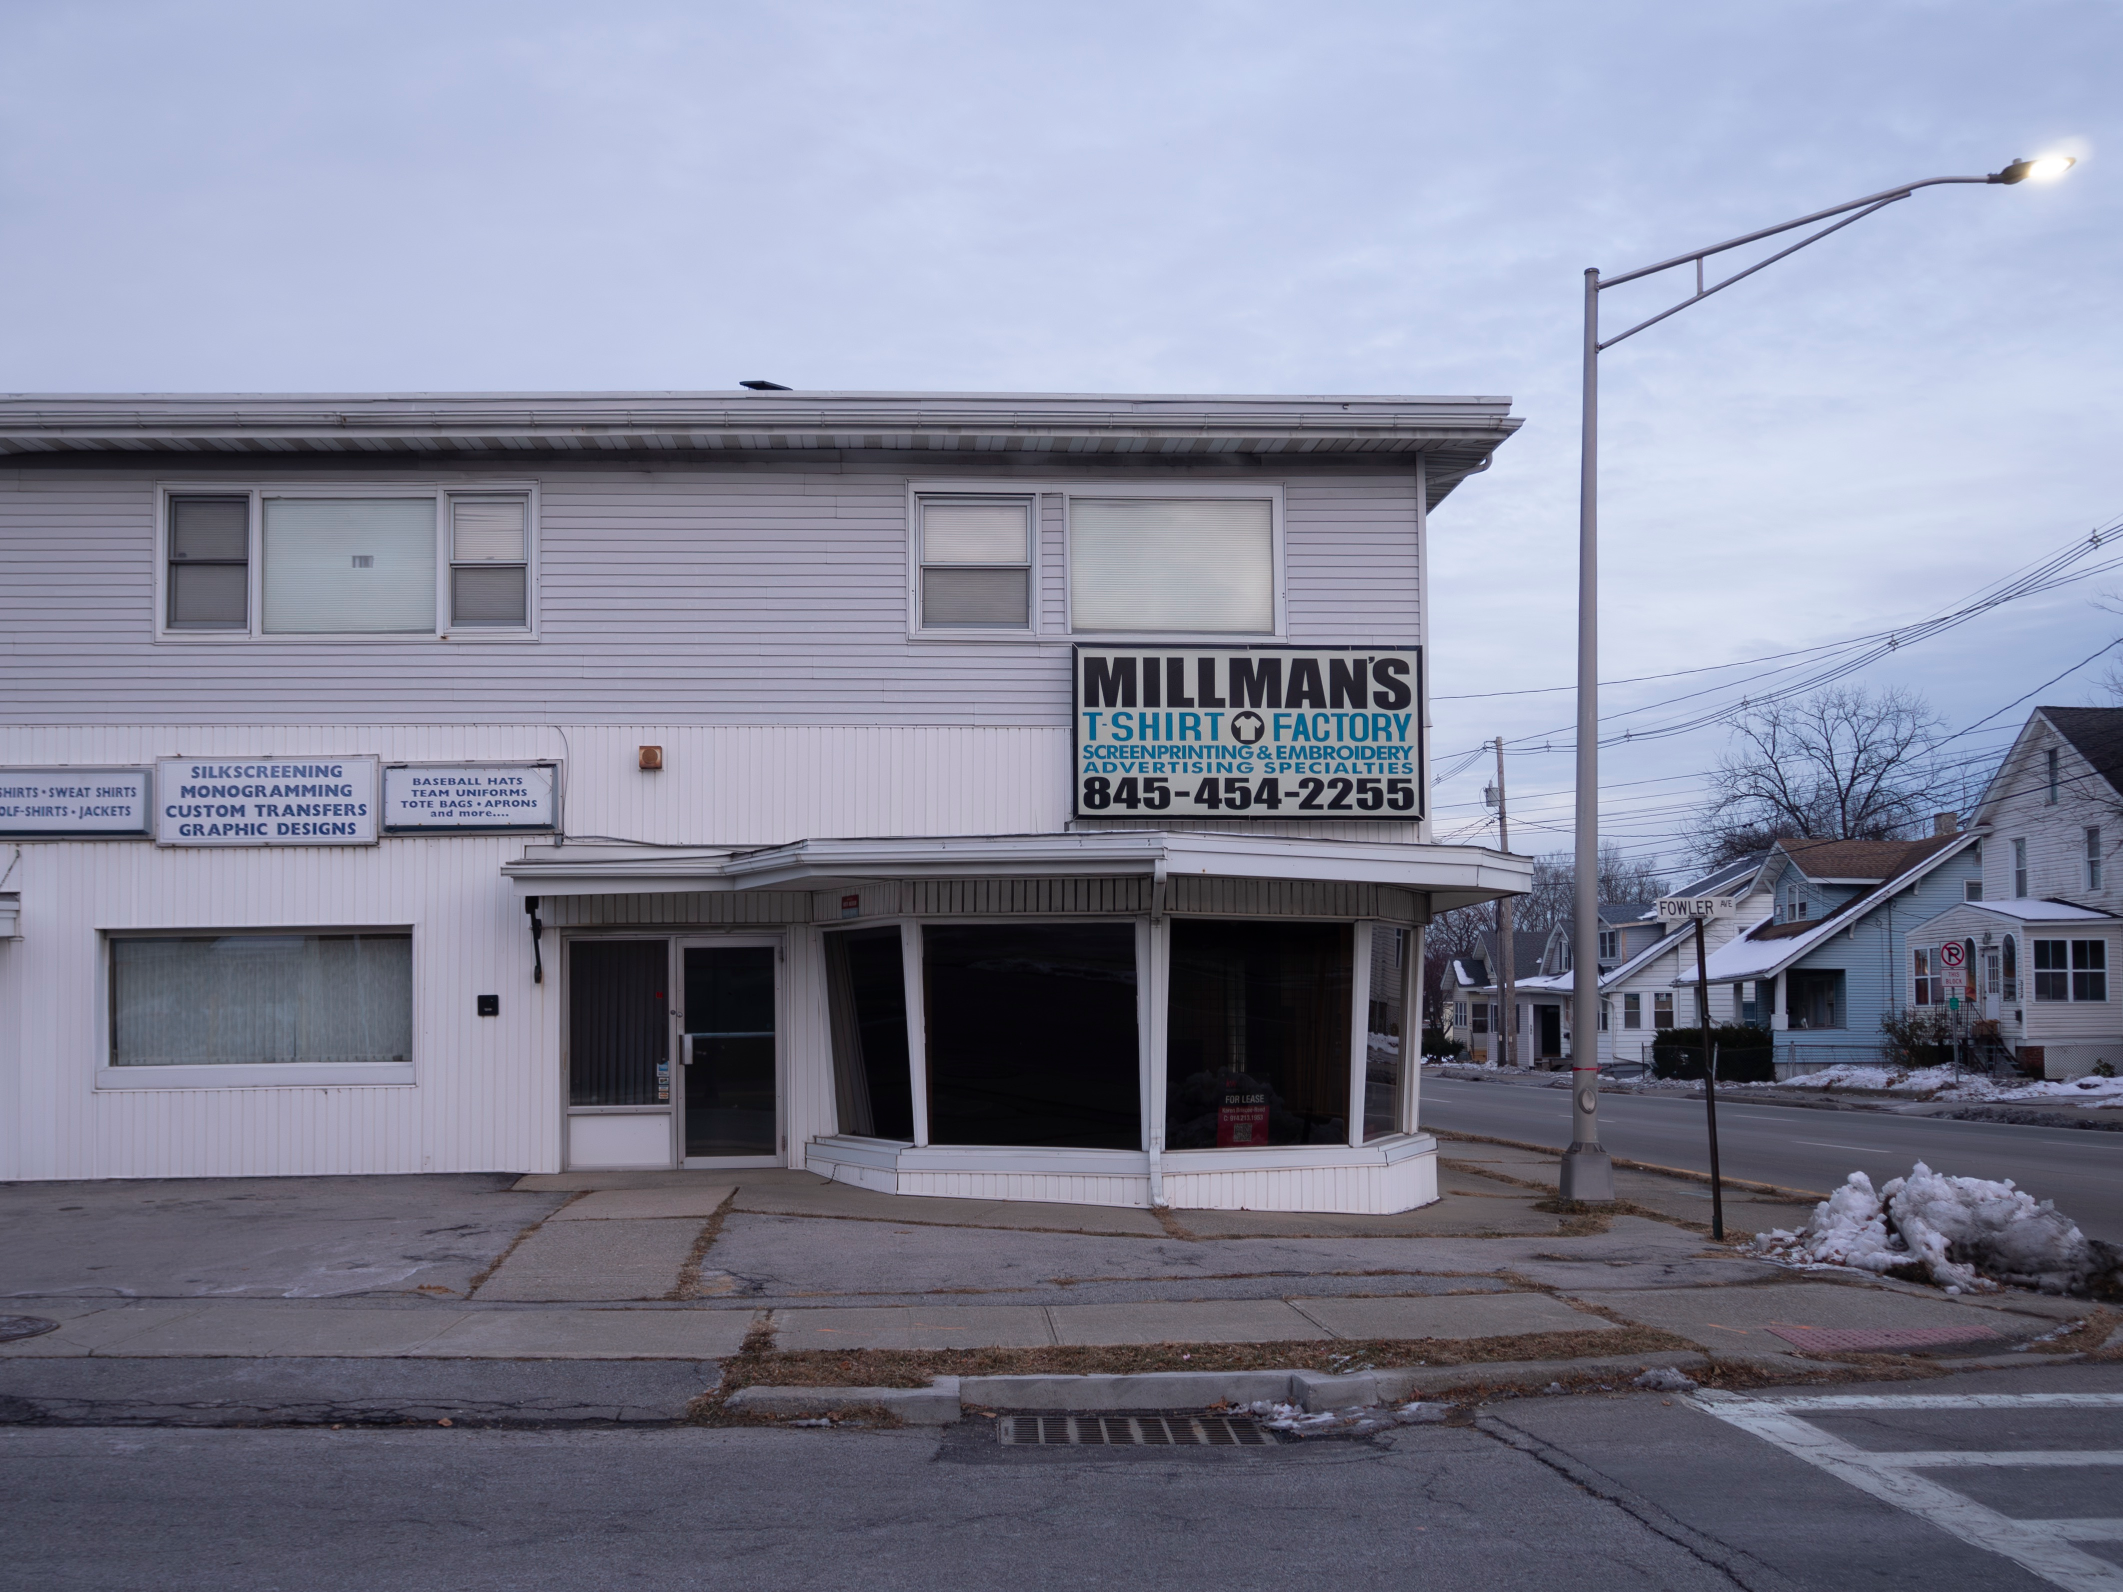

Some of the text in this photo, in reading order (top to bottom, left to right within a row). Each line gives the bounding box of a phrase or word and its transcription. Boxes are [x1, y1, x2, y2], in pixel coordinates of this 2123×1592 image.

[1083, 656, 1412, 711] MILLMAN'S
[1082, 712, 1412, 742] T-SHIRT FACTORY
[1083, 745, 1414, 761] SCREENPRINTING & EMBROIDERY
[191, 765, 343, 779] SILKSCREENING
[1083, 762, 1414, 775] ADVERTISING SPECIALTIES
[412, 777, 523, 786] BASEBALL HATS
[48, 786, 91, 798] SWEAT
[95, 786, 137, 798] SHIRTS
[180, 784, 353, 798] MONOGRAMMING
[411, 788, 528, 798] TEAM UNIFORMS
[1083, 776, 1415, 811] 845-454-2255
[165, 804, 367, 818] CUSTOM TRANSFERS
[400, 799, 538, 809] TOTE BAGS APRONS
[79, 806, 131, 819] JACKETS
[430, 809, 452, 818] and
[178, 822, 357, 837] GRAPHIC DESIGNS
[1659, 900, 1714, 916] FOWLER
[1242, 1095, 1264, 1103] LEASE
